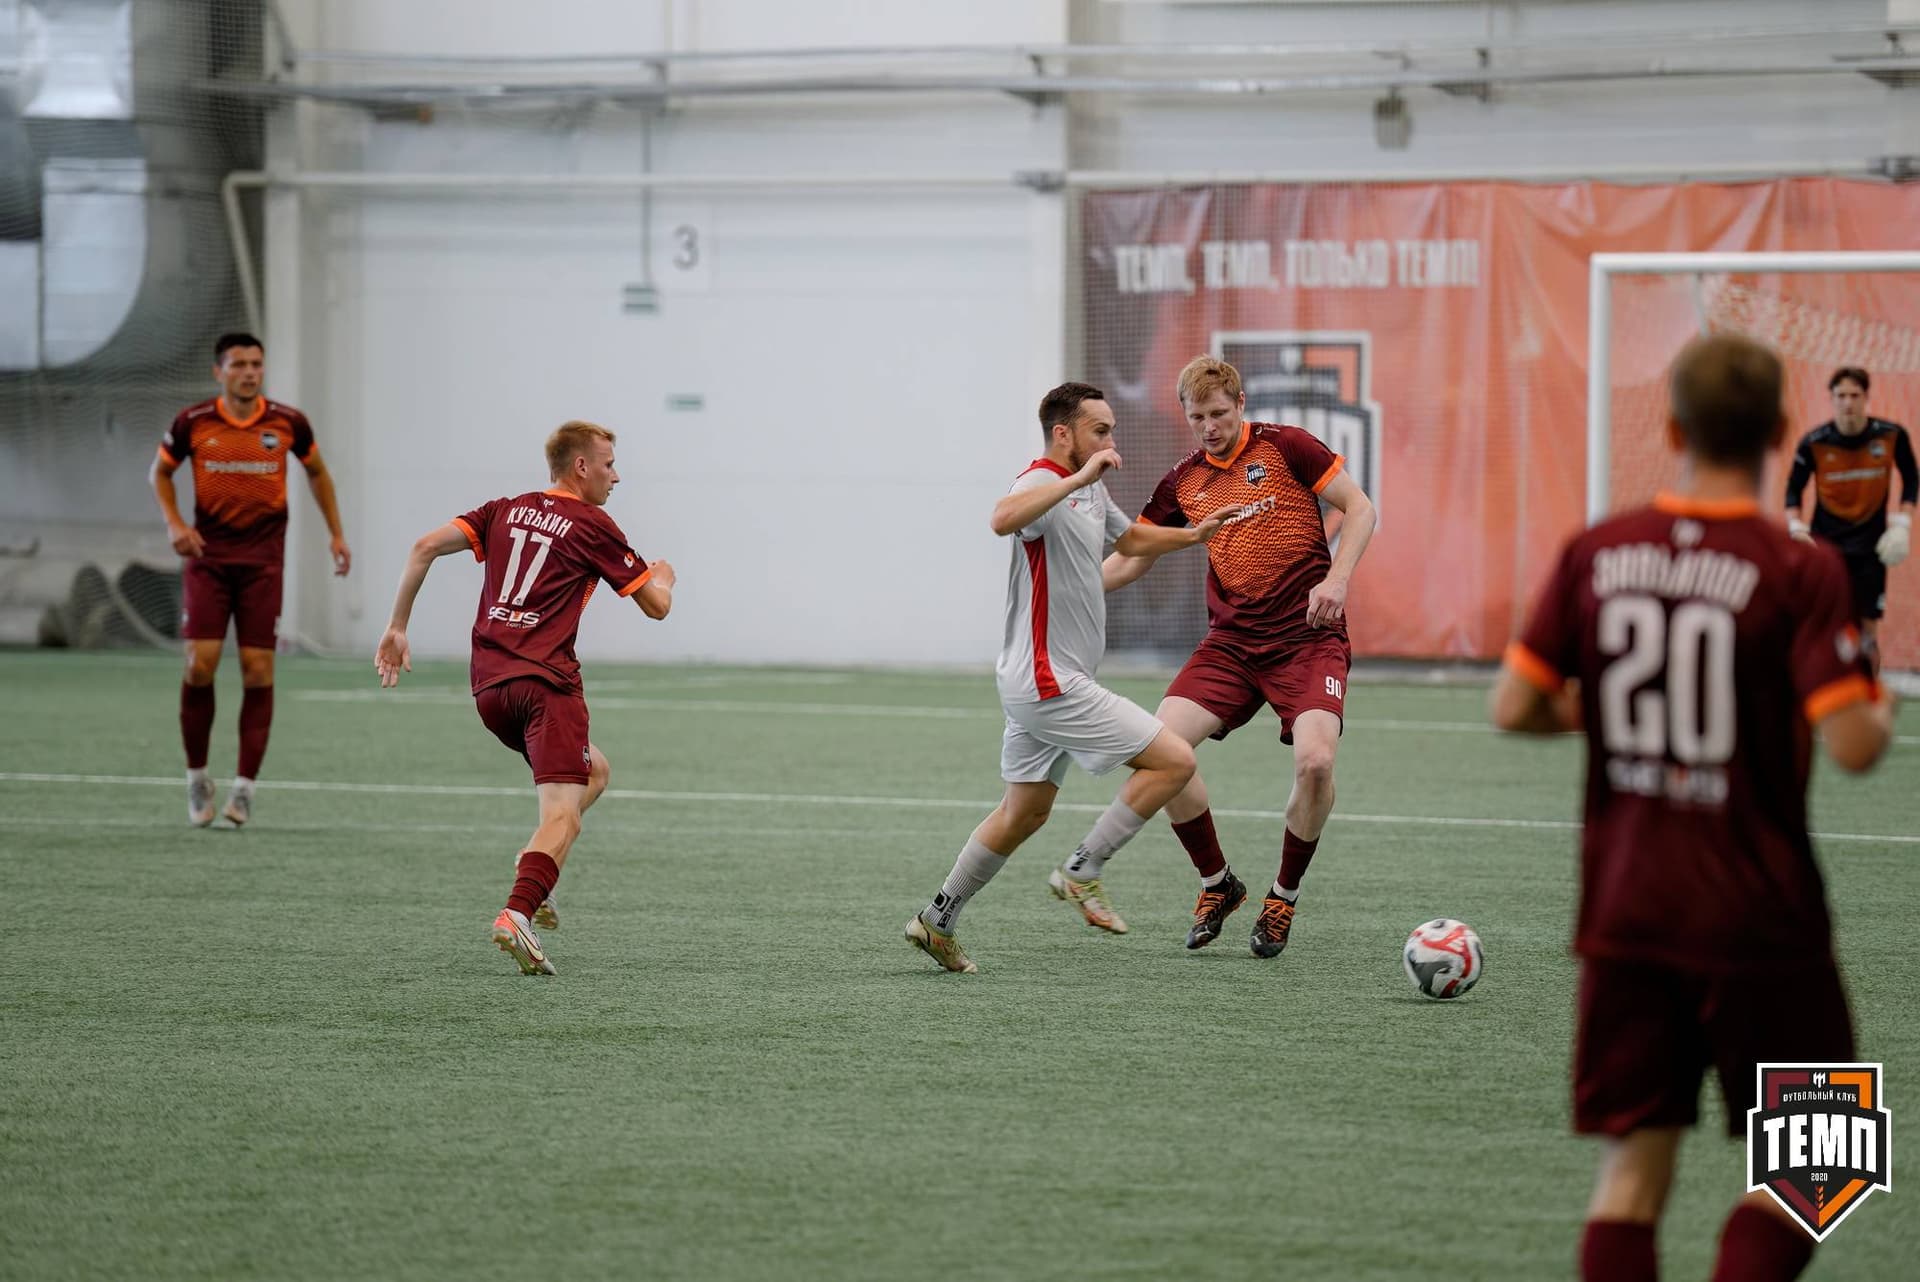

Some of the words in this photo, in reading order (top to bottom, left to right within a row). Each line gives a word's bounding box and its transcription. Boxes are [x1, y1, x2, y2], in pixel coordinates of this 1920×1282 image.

[672, 224, 700, 271] 3
[507, 507, 573, 538] КУЗЬКИН
[498, 528, 553, 606] 17
[1325, 675, 1342, 700] 90
[1598, 597, 1736, 764] 20
